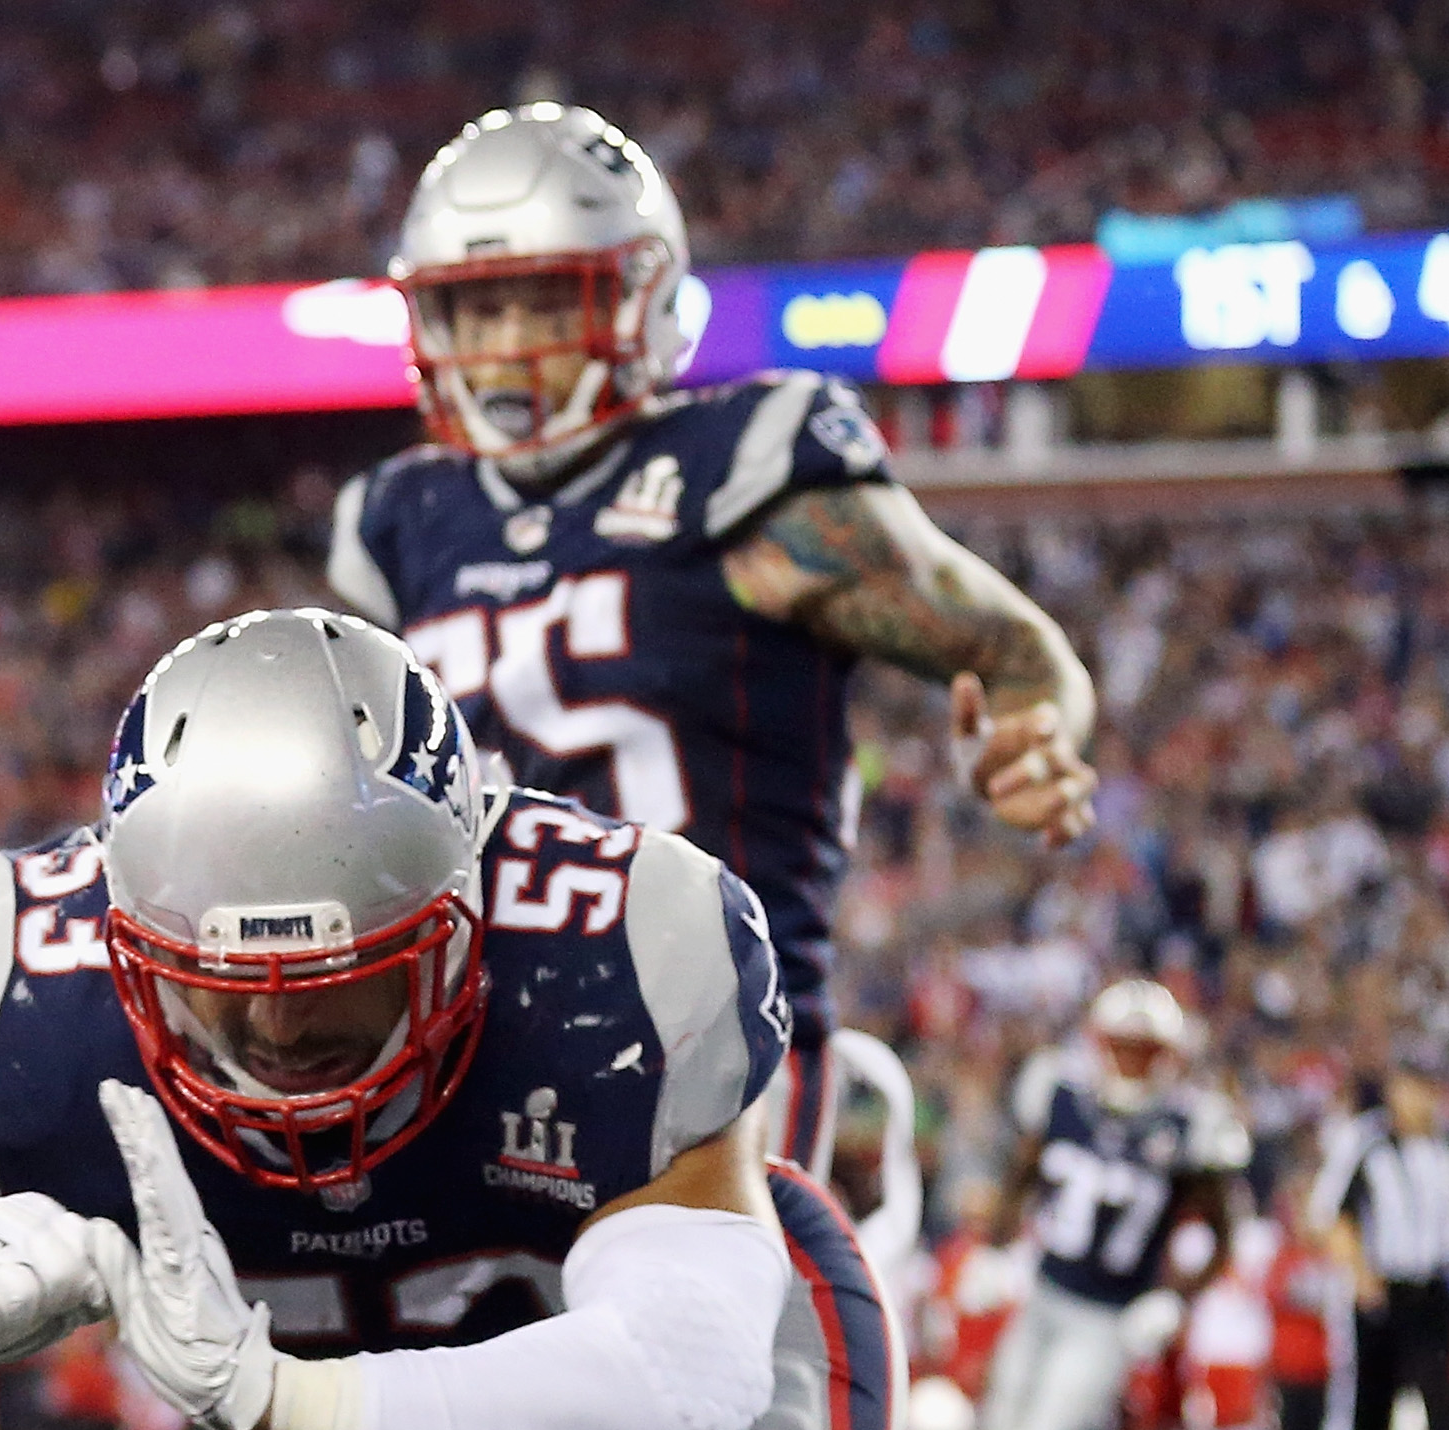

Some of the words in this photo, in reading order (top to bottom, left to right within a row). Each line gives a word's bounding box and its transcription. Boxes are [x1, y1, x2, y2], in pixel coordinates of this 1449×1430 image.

[487, 803, 642, 936] 53
[483, 1163, 596, 1211] CHAMPIONS
[289, 1217, 429, 1258] PATRIOTS
